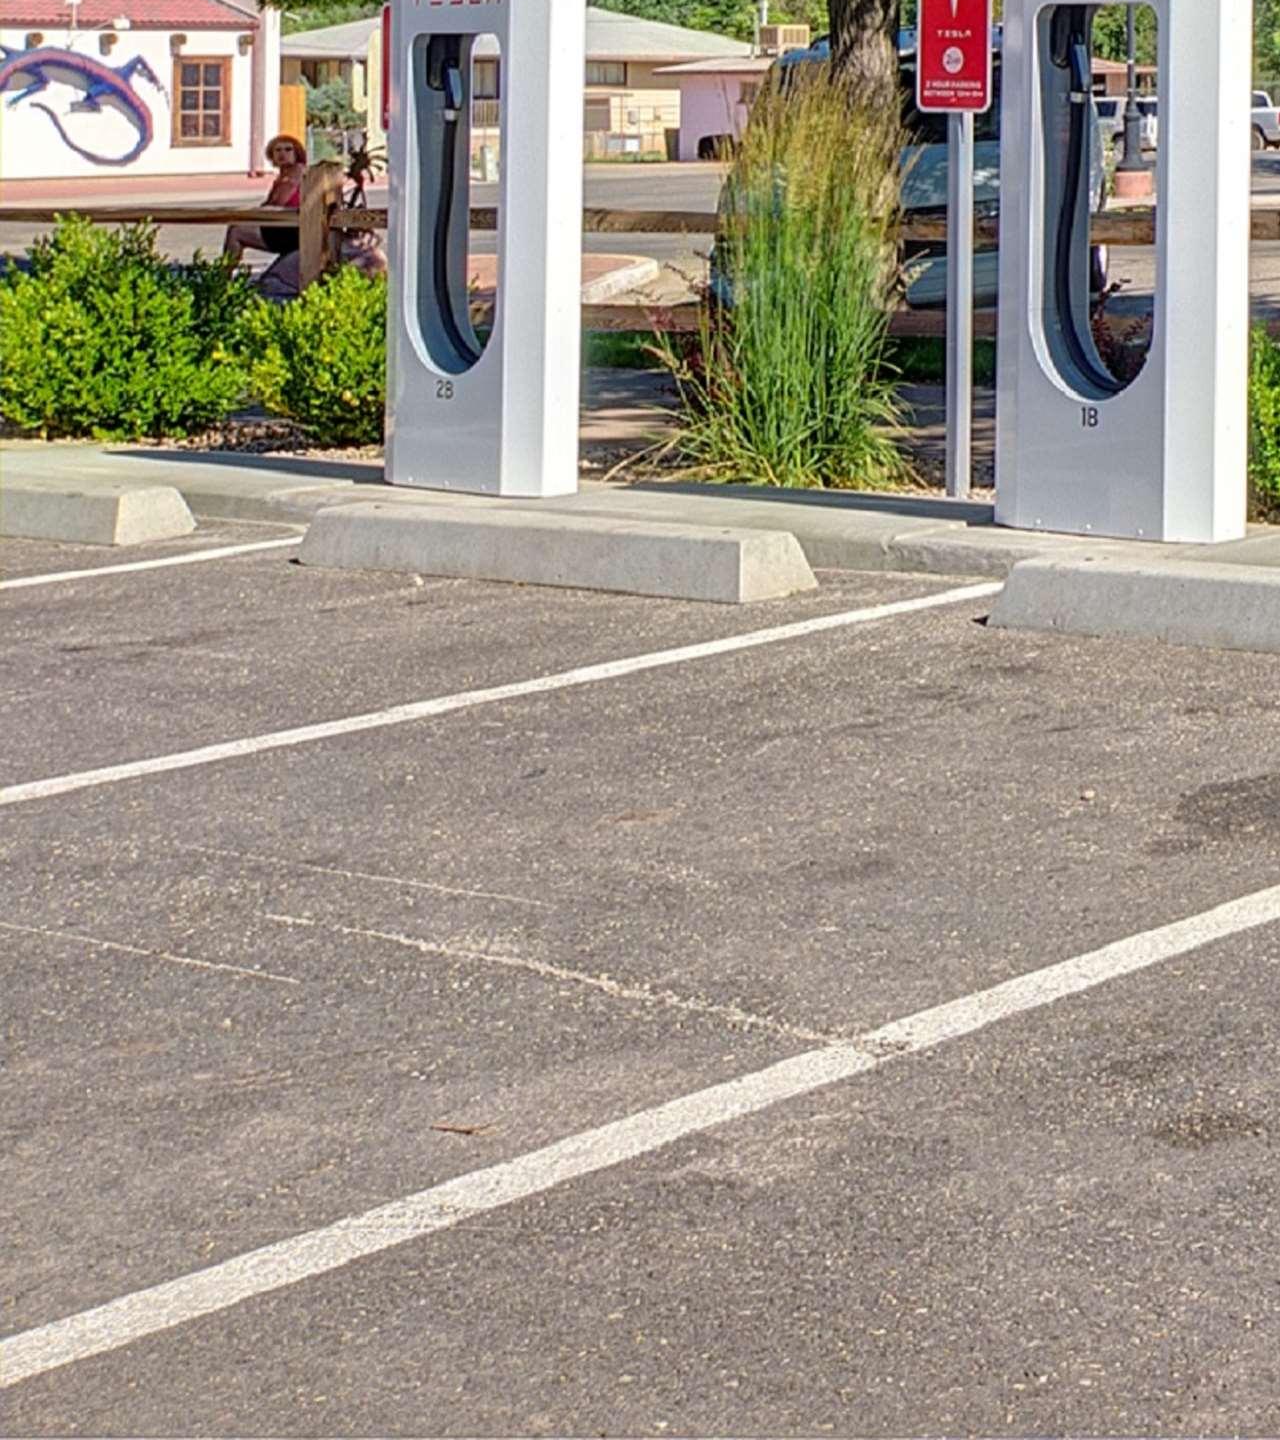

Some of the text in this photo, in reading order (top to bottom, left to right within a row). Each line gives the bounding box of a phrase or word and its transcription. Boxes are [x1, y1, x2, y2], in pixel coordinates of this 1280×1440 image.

[936, 29, 972, 39] TESLA
[436, 379, 454, 400] 2B
[1081, 406, 1098, 427] 1B
